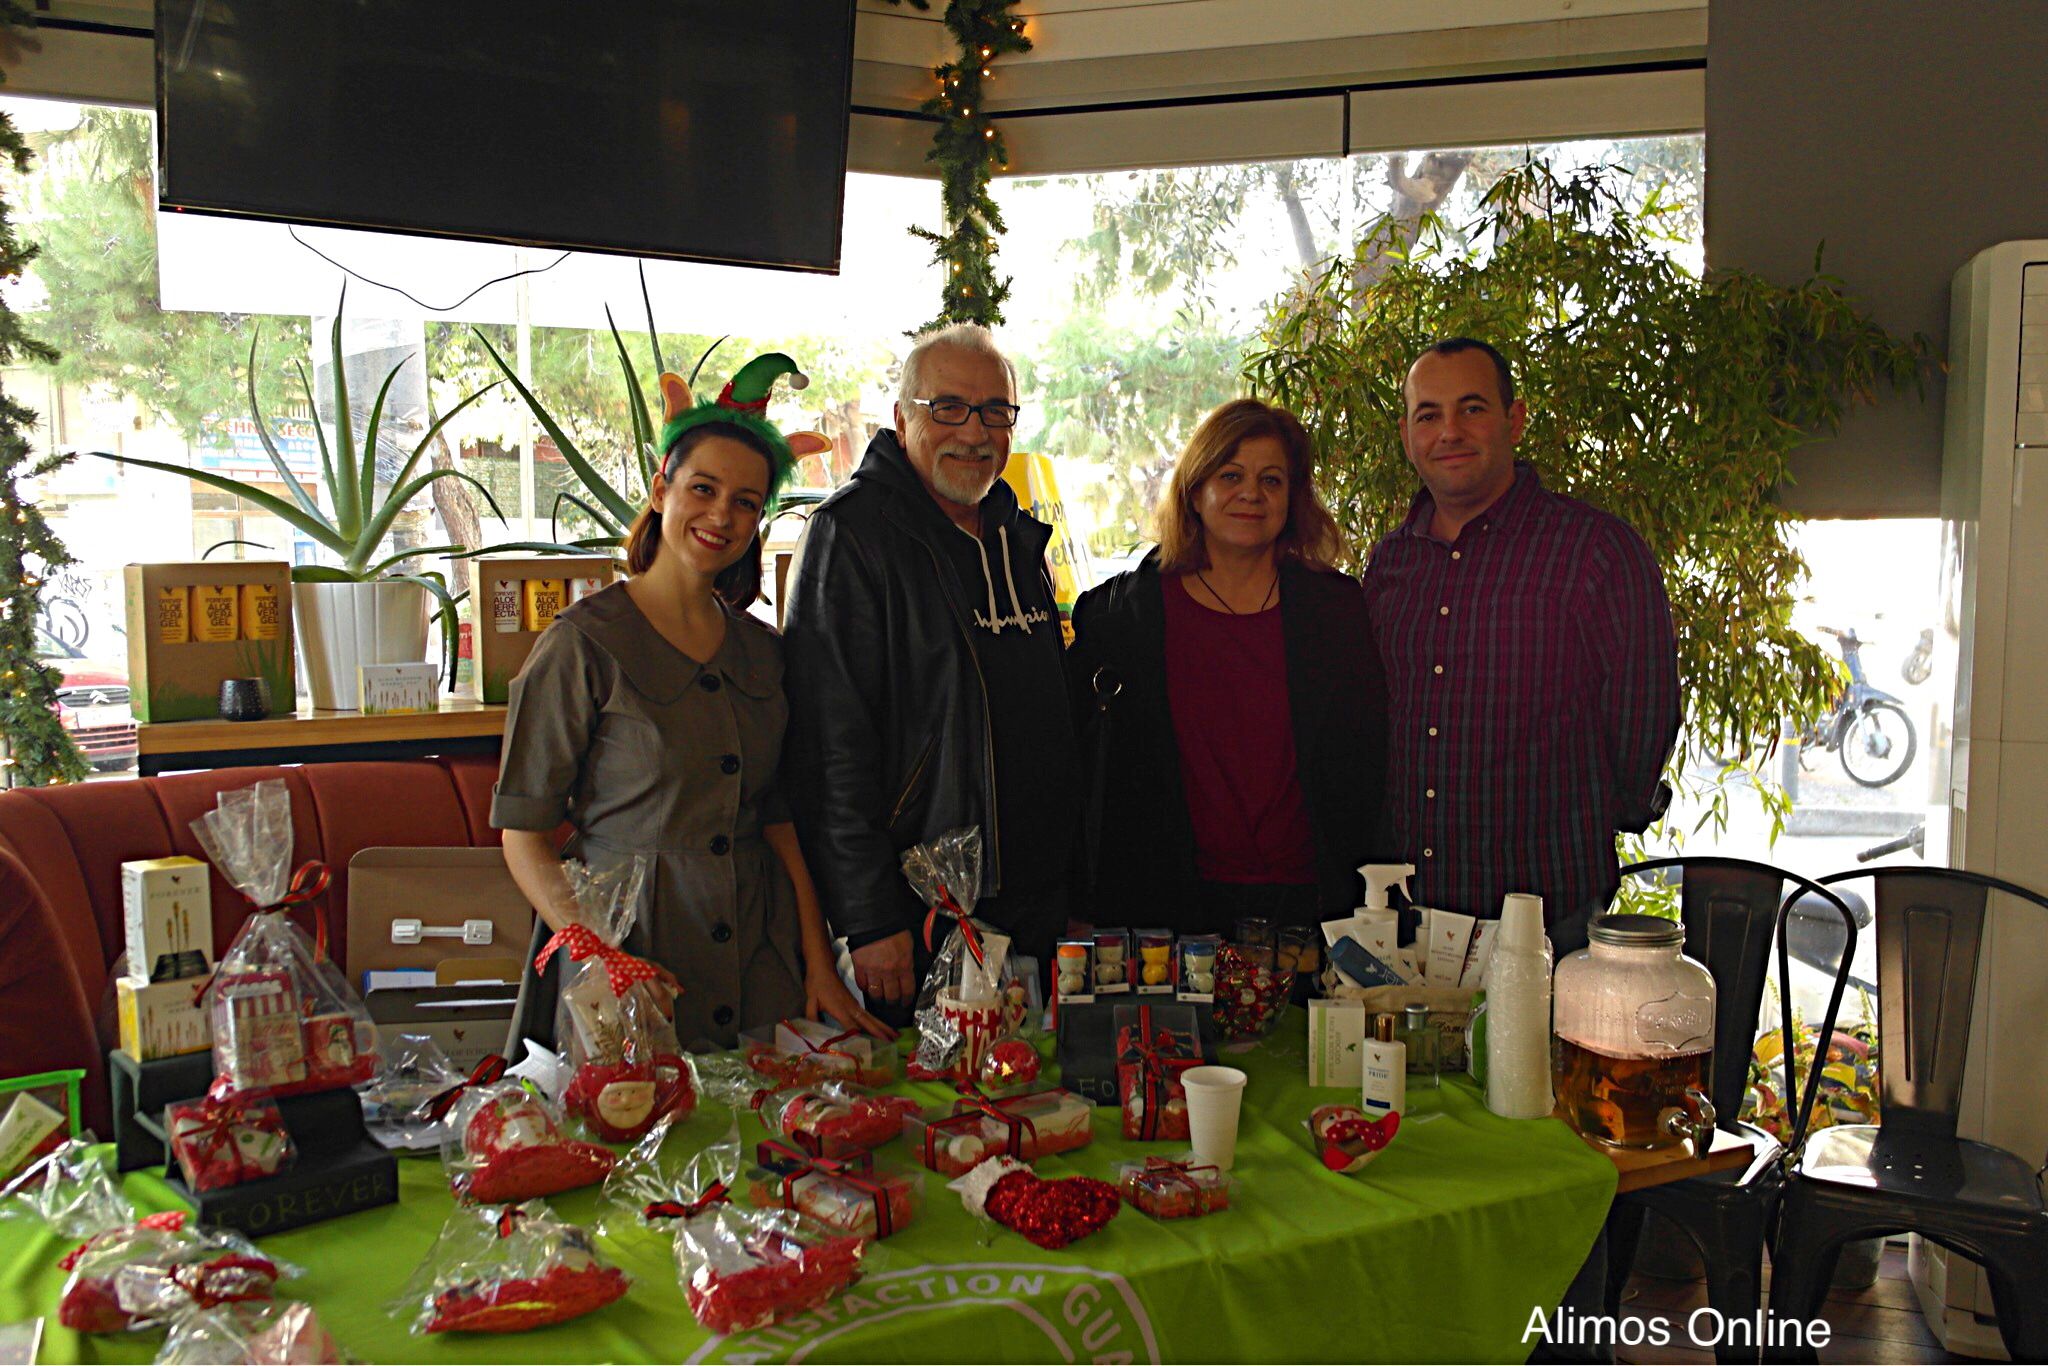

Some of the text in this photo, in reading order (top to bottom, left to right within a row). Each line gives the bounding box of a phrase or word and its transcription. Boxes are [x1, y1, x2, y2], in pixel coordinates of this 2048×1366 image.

[208, 602, 232, 610] ALOE
[536, 603, 560, 611] VERA
[207, 609, 232, 618] VERA
[160, 619, 181, 627] GEL
[211, 618, 231, 626] GEL
[261, 616, 279, 624] GEL
[213, 1172, 393, 1229] FOREVER
